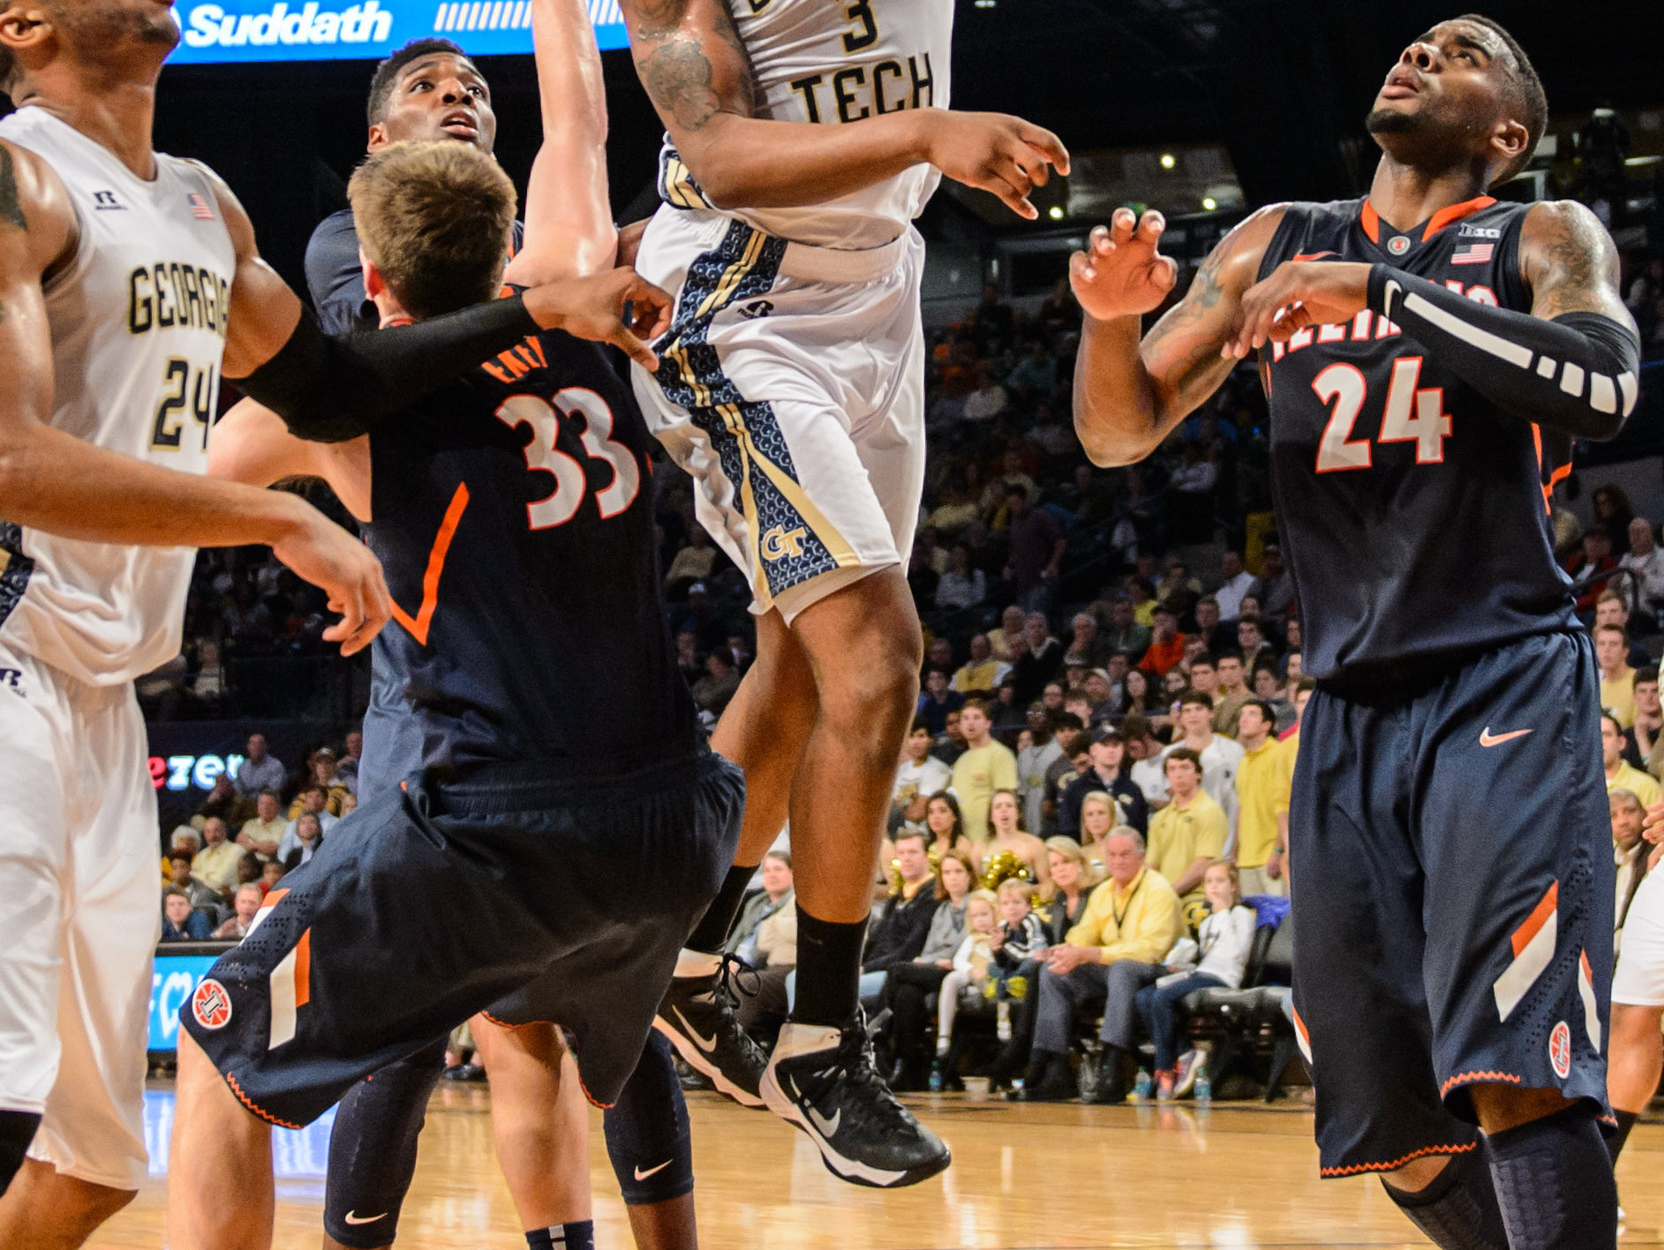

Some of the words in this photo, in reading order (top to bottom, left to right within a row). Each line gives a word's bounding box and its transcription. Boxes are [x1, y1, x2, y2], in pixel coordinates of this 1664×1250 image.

[185, 0, 393, 48] Suddath
[790, 51, 933, 124] TECH
[149, 354, 214, 453] 24
[1311, 356, 1452, 474] 24
[494, 387, 640, 531] 33
